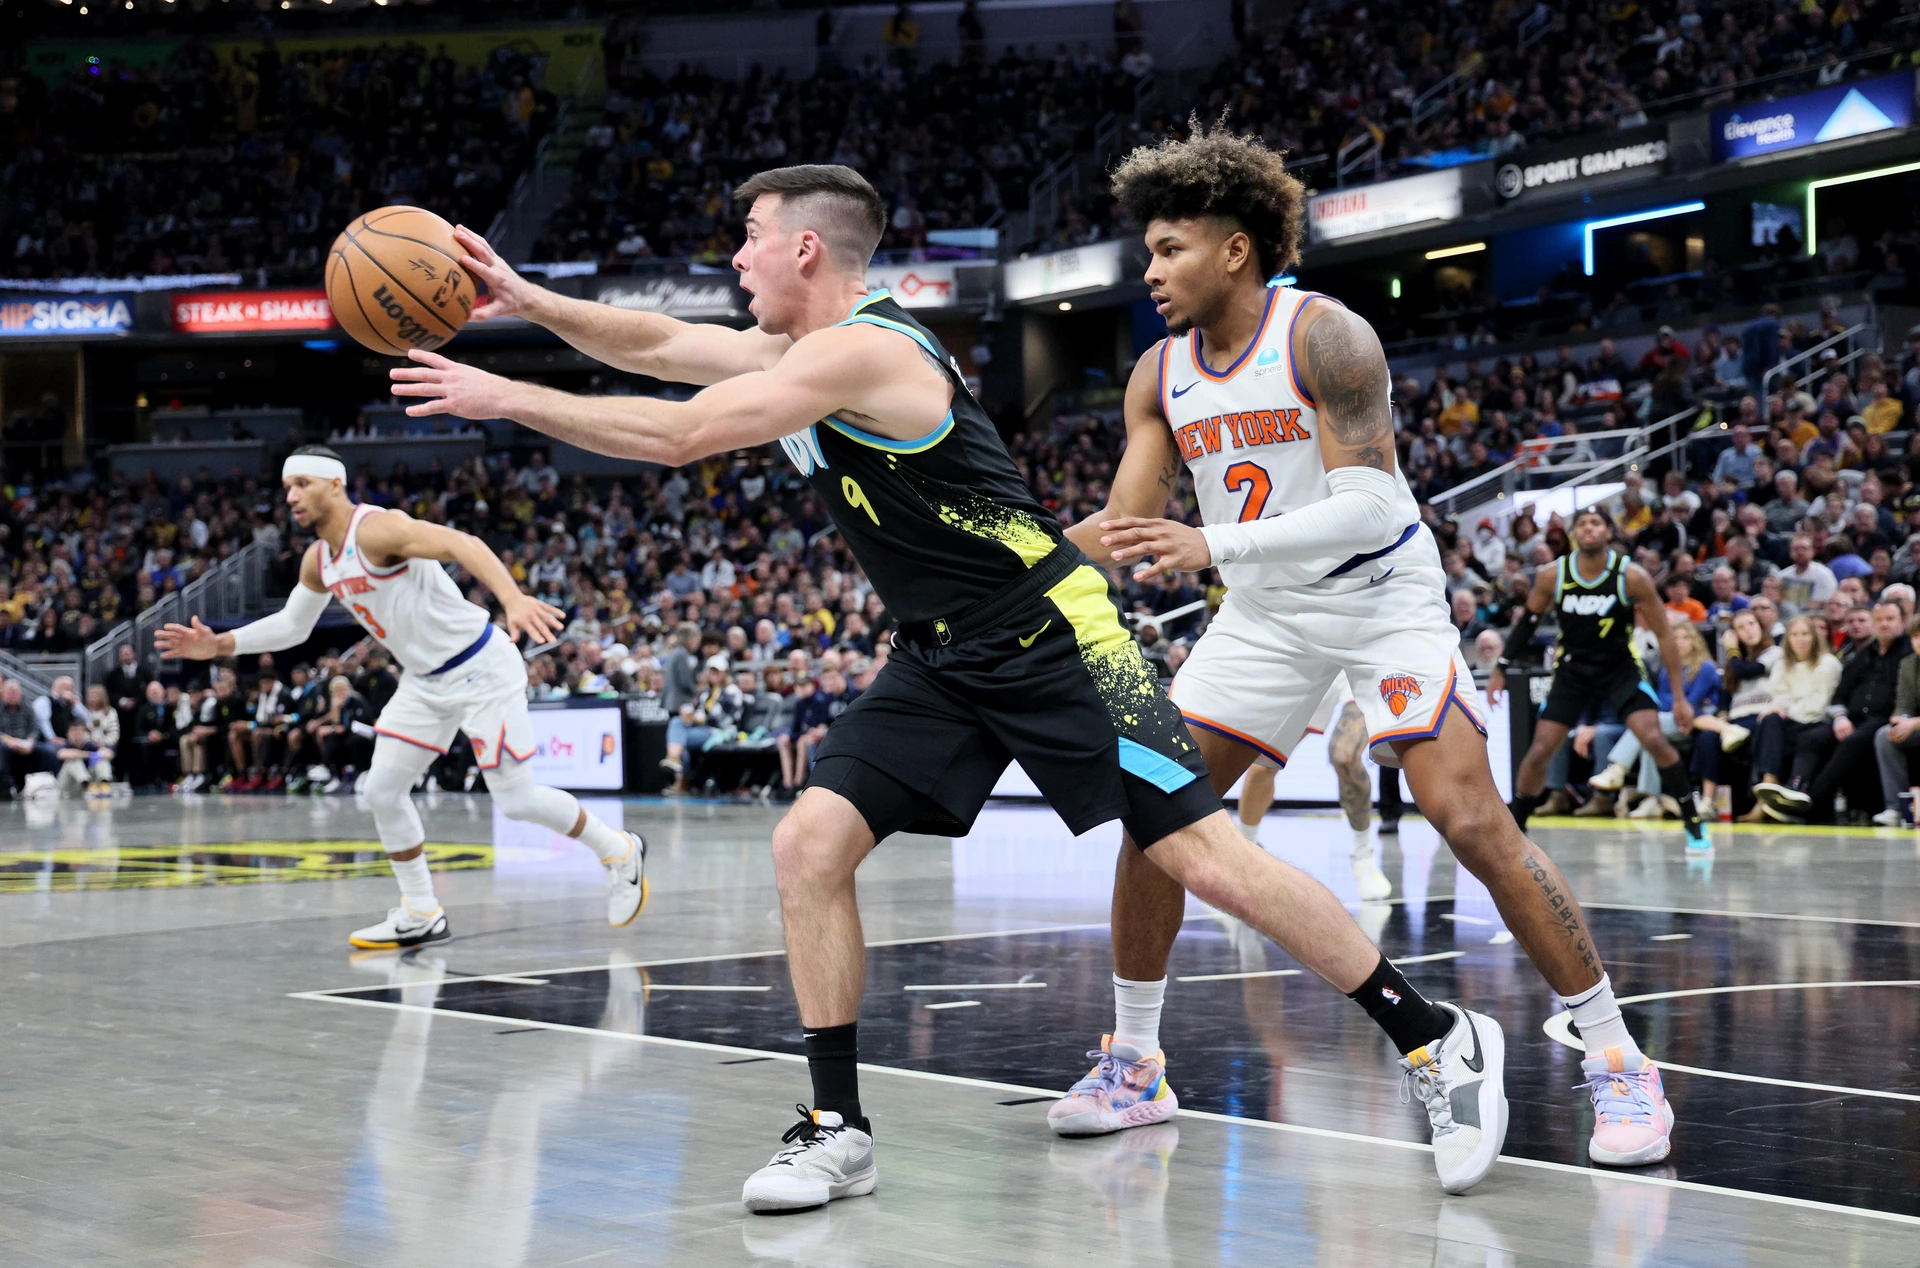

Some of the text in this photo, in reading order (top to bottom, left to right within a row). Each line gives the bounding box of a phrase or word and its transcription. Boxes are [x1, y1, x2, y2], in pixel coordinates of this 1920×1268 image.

[1724, 113, 1794, 140] Elevance
[1524, 157, 1579, 187] SPORT
[1580, 140, 1667, 176] GRAPHICS
[1314, 192, 1367, 221] INDIANA
[177, 302, 244, 323] STEAK
[260, 299, 331, 321] SHAKE
[1254, 363, 1283, 378] sphere
[1174, 408, 1311, 463] NEW YORK
[841, 475, 881, 526] 9
[1223, 460, 1275, 524] 2
[1561, 594, 1617, 616] INDY
[353, 603, 386, 638] 3
[1598, 617, 1614, 638] 7
[1380, 675, 1422, 699] KNICKS
[1525, 856, 1579, 936] GOLDEN
